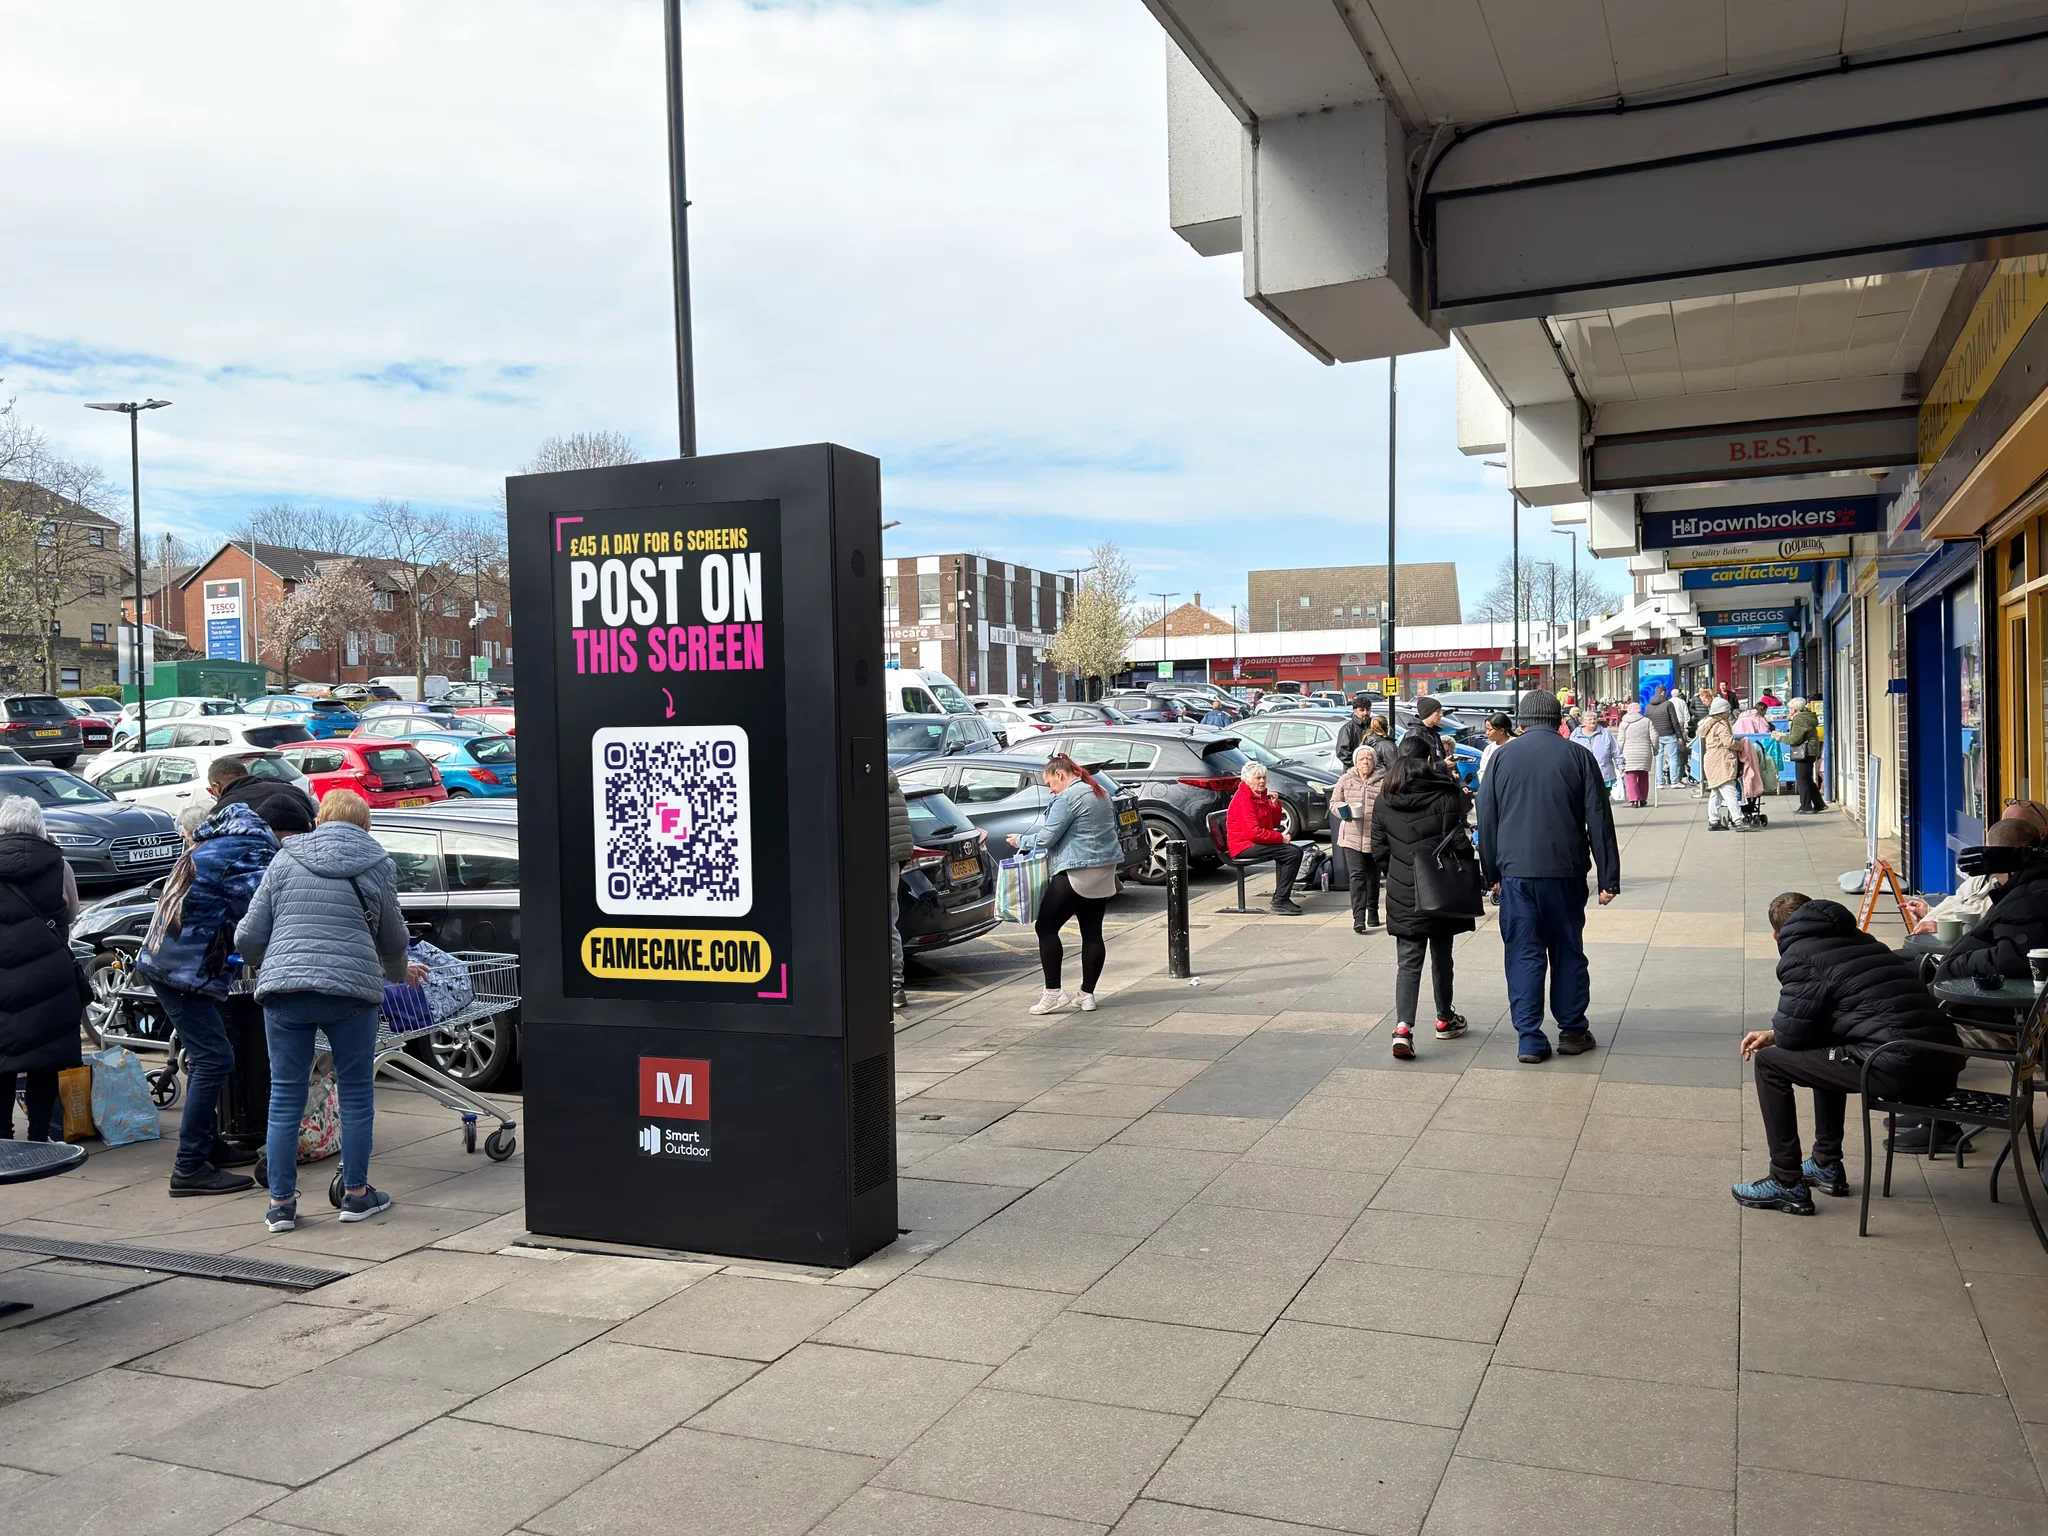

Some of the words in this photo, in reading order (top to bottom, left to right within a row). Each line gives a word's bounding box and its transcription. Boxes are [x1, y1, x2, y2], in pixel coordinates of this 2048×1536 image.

[1958, 256, 2027, 404] COMMUNITY
[1729, 433, 1822, 461] B.E.S.T.
[1700, 510, 1836, 536] pawnbrokers
[570, 535, 597, 557] £45
[601, 534, 610, 555] A
[614, 533, 639, 555] DAY
[644, 532, 669, 553] FOR
[674, 531, 683, 551] 6
[687, 528, 748, 550] SCREENS
[1691, 548, 1720, 559] Quality
[1722, 547, 1749, 556] Bakers
[1711, 565, 1799, 581] cardfactory
[570, 556, 683, 627] POST
[700, 552, 763, 623] ON
[1731, 610, 1784, 622] GREGGS
[572, 627, 638, 674] THIS
[648, 623, 764, 672] SCREEN
[1399, 650, 1475, 660] poundstretcher
[1245, 656, 1315, 666] poundstretcher
[1386, 679, 1396, 692] H
[133, 849, 153, 859] YV68
[155, 847, 170, 856] LLJ
[590, 937, 761, 973] FAMECAKE.COM
[656, 1072, 692, 1105] M
[665, 1129, 700, 1142] Smart
[665, 1142, 710, 1156] Outdoor
